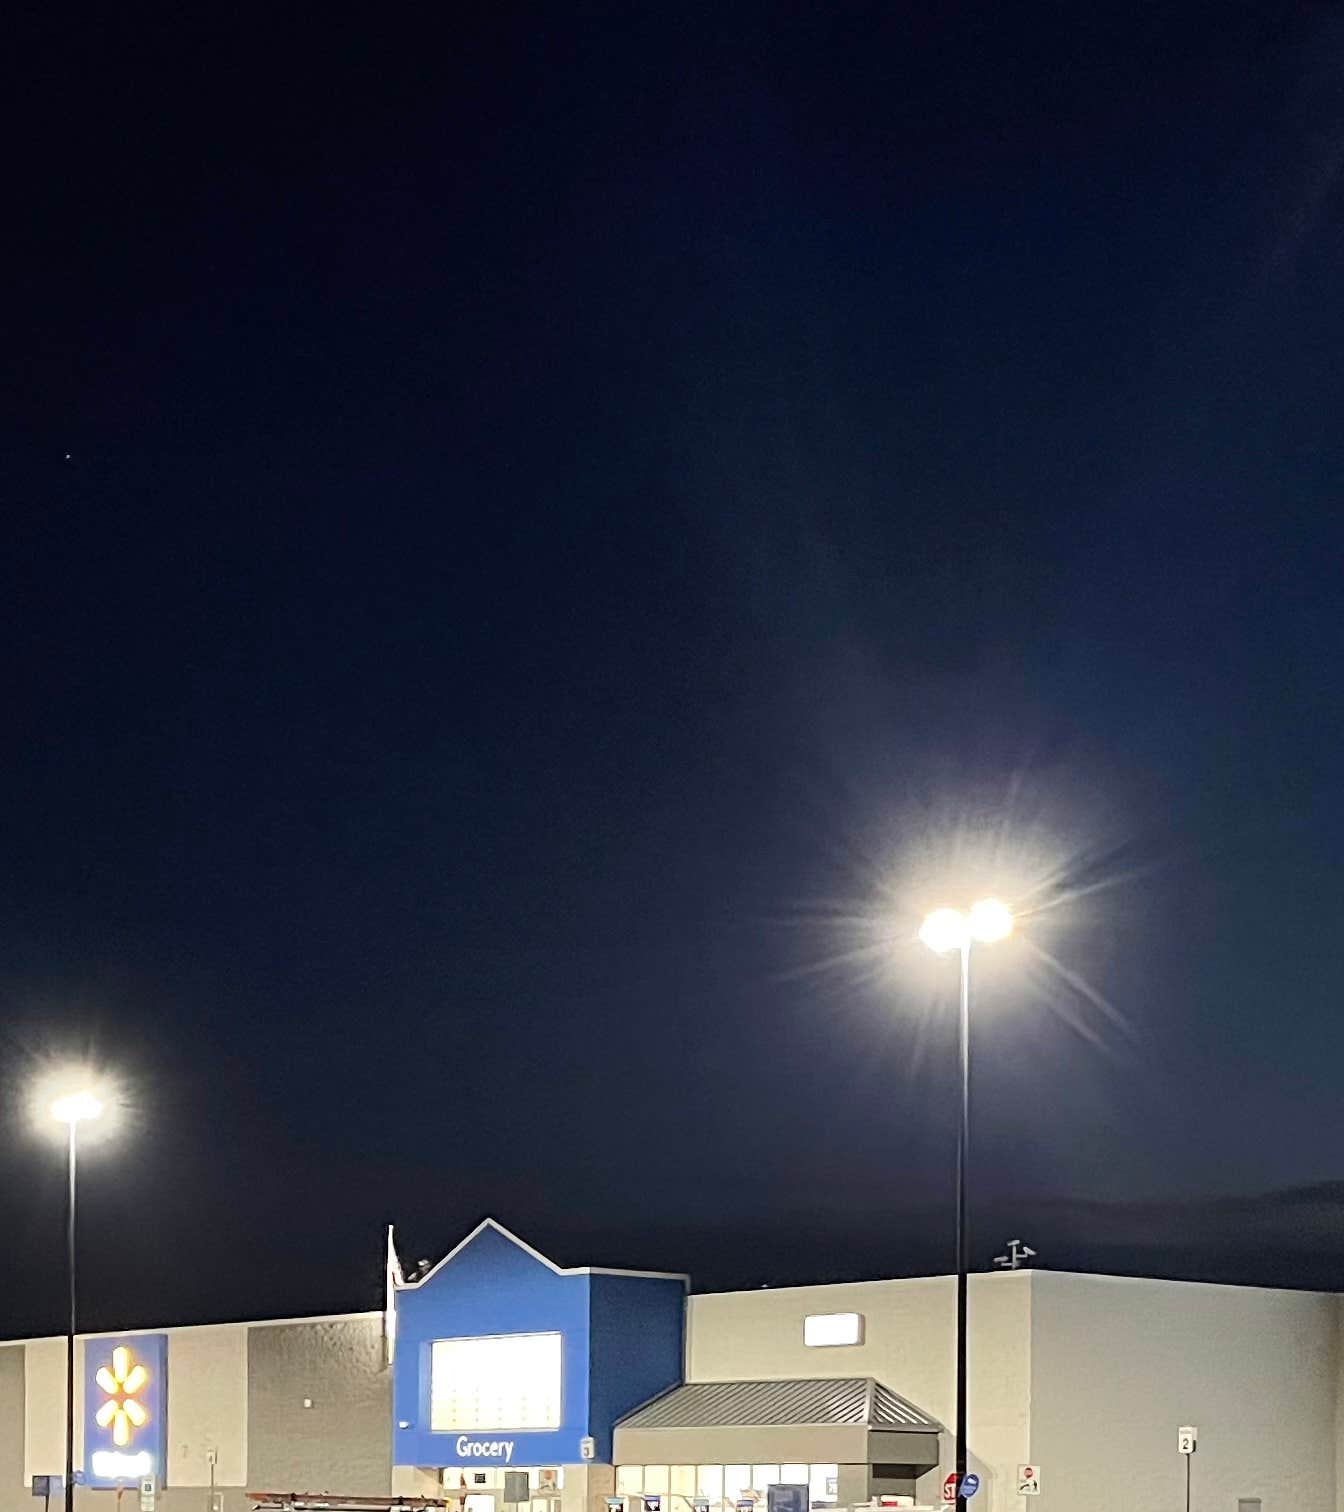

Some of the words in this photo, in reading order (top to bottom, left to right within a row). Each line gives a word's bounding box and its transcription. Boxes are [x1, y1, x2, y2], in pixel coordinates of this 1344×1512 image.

[456, 1435, 514, 1463] Grocery
[1182, 1437, 1190, 1450] 2
[944, 1483, 956, 1498] ST
